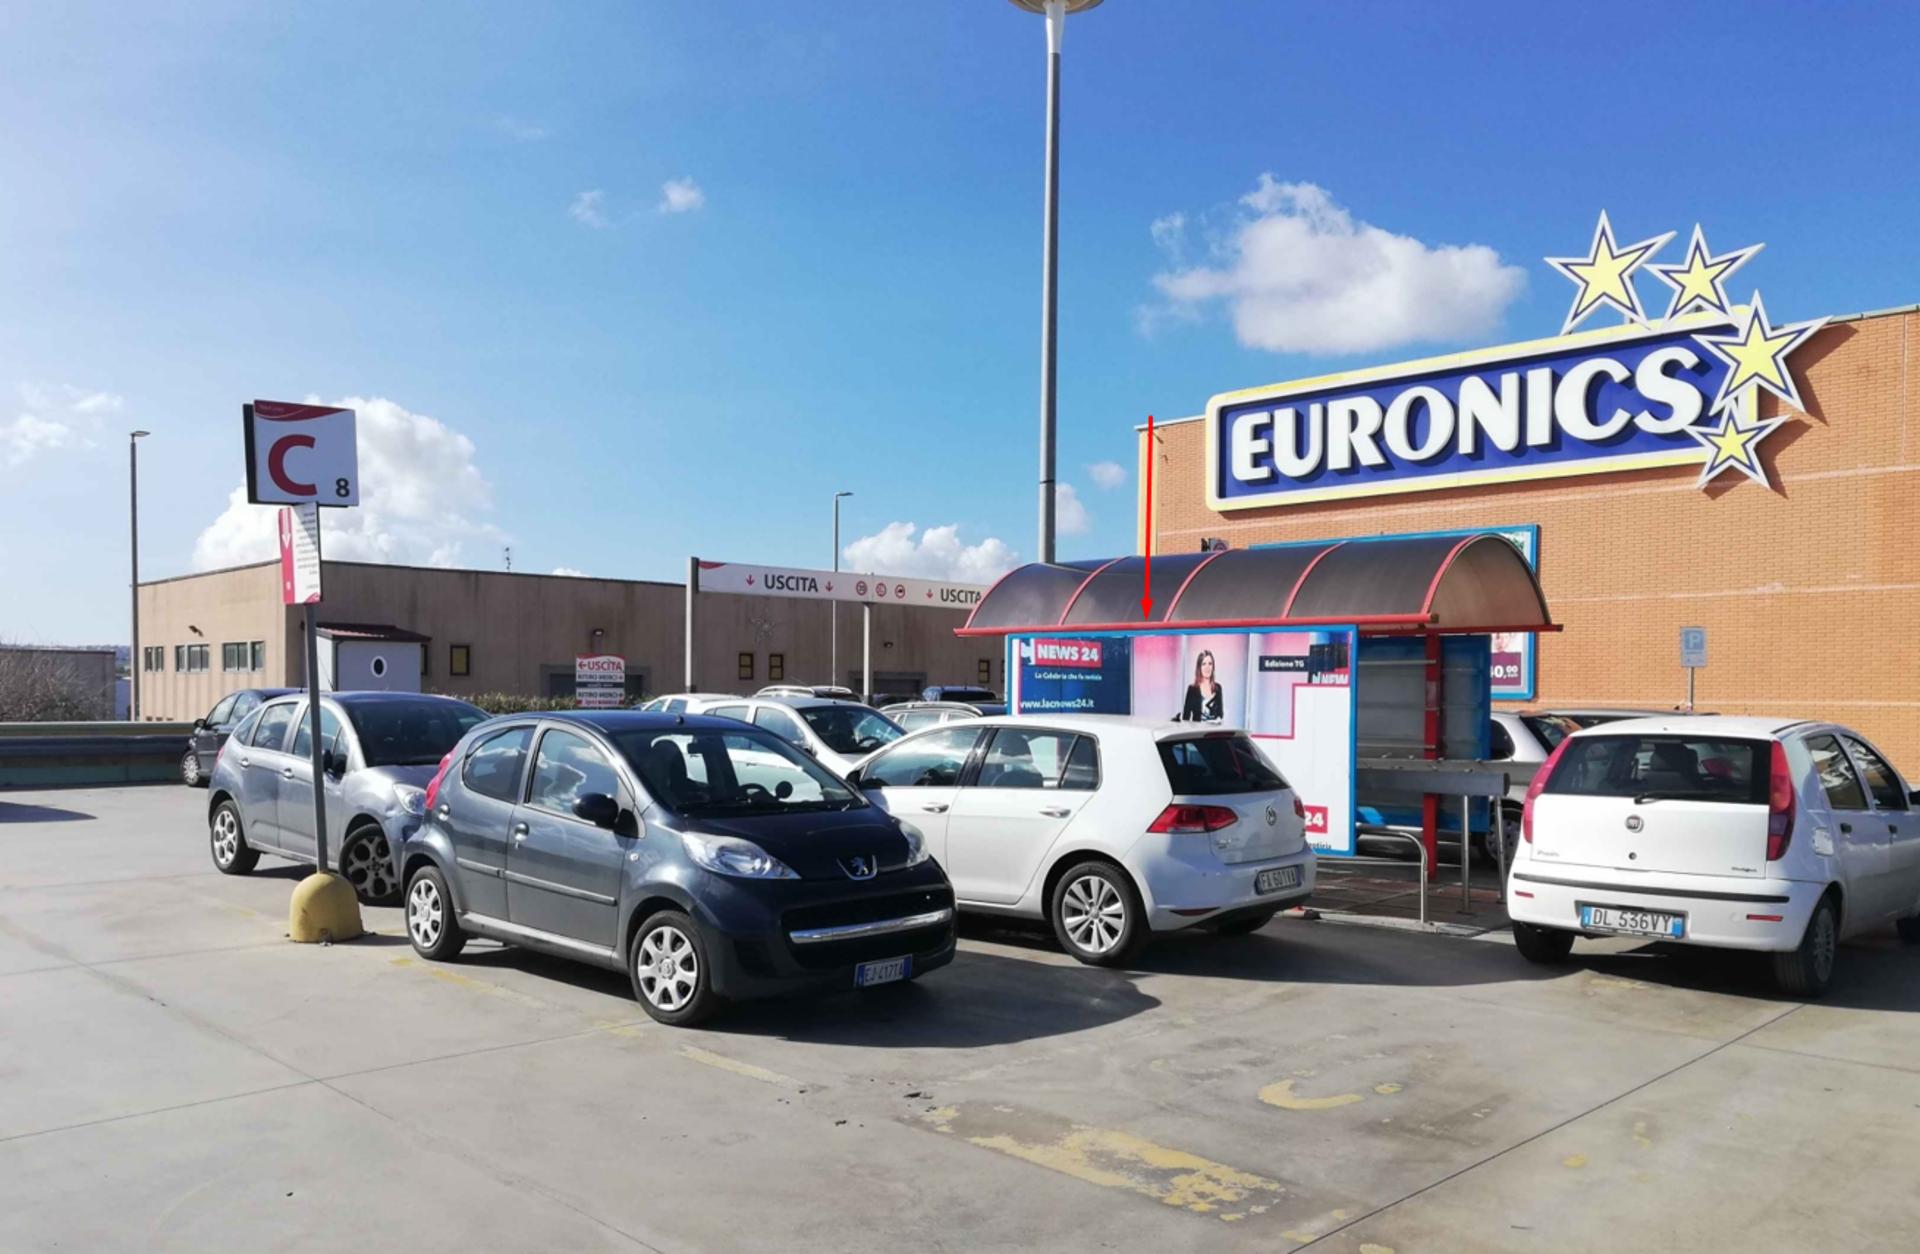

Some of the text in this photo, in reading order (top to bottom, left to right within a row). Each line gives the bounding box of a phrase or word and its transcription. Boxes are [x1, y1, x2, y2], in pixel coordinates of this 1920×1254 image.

[1231, 346, 1701, 481] EURONICS
[267, 434, 318, 497] C
[335, 477, 350, 498] 8
[764, 573, 818, 592] USCITA
[940, 587, 982, 604] USCITA
[1689, 632, 1701, 649] P
[1036, 643, 1099, 662] NEWS 24
[587, 660, 623, 672] USCITA
[1305, 811, 1324, 827] 24
[1593, 908, 1672, 932] DL 536VY
